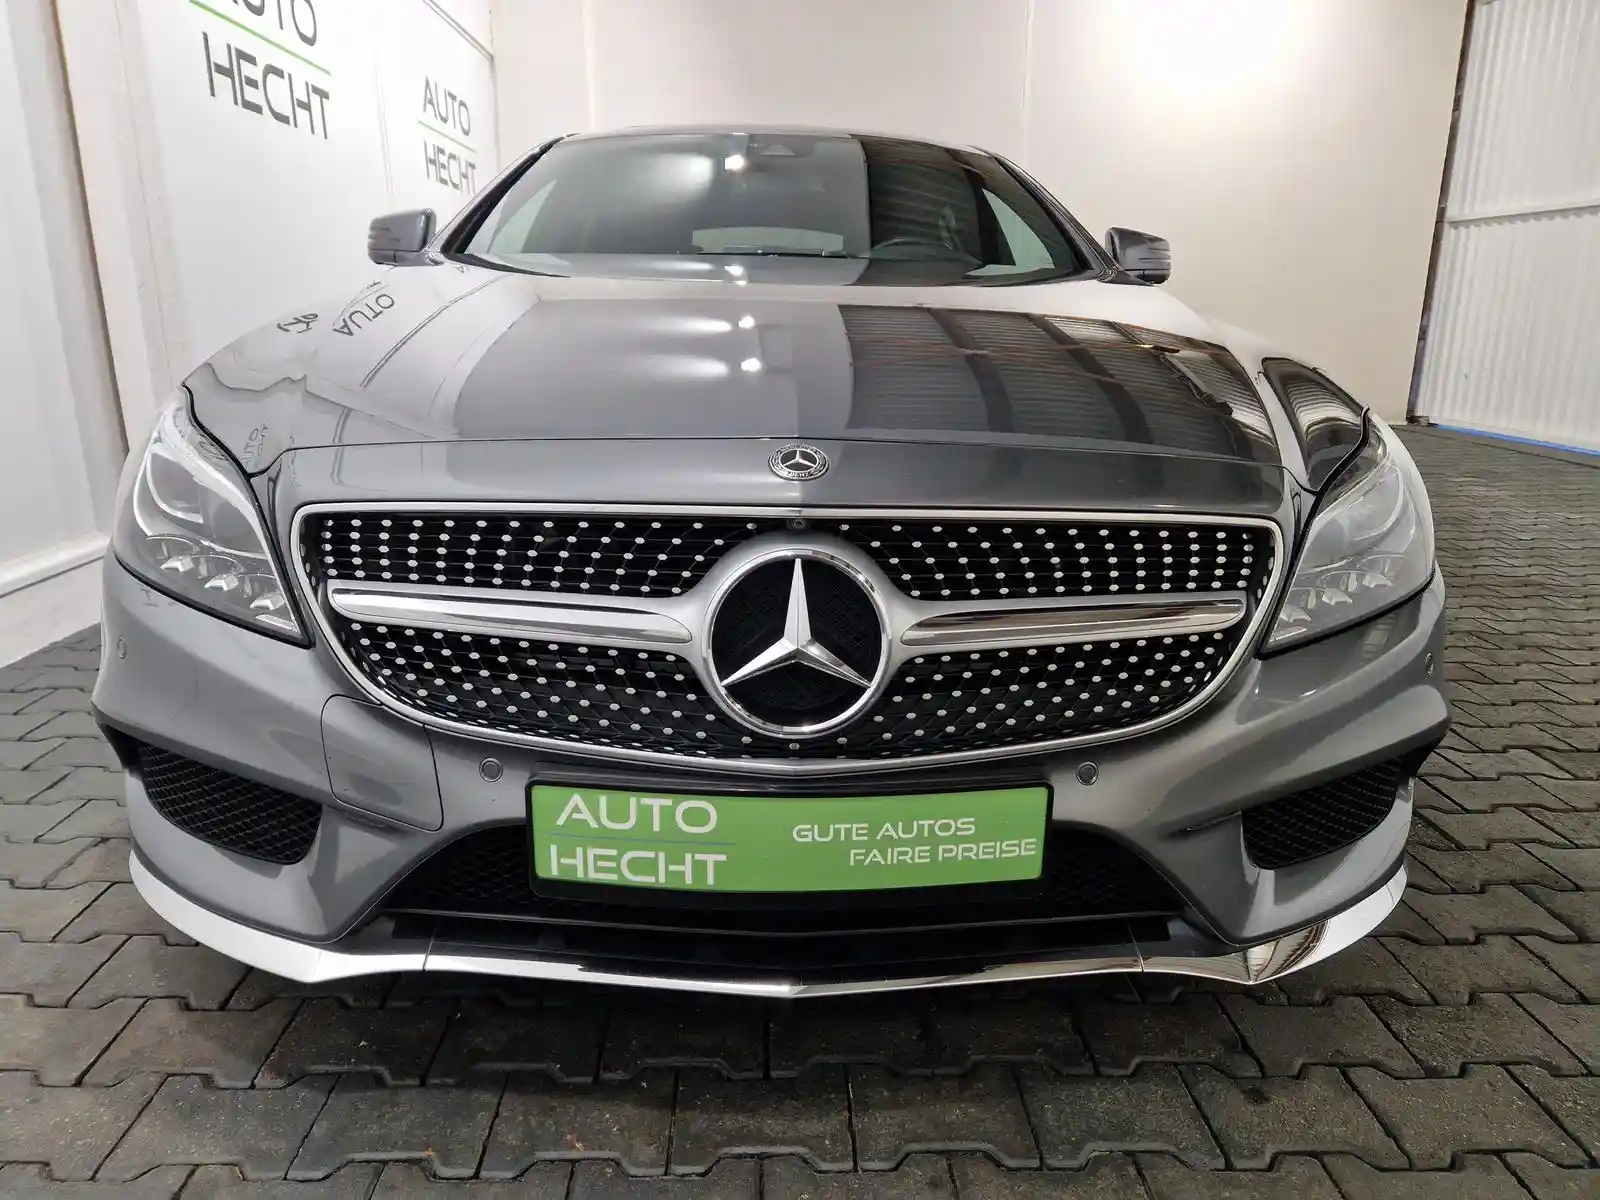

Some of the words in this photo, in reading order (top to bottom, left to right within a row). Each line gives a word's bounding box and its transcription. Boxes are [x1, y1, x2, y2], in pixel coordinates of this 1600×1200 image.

[202, 31, 330, 139] HECHT
[422, 76, 471, 136] AUTO
[423, 140, 476, 195] HECHT
[556, 793, 718, 834] AUTO
[792, 824, 868, 842] GUTE
[876, 817, 976, 840] AUTOS
[550, 844, 727, 885] HECHT
[850, 845, 931, 866] FAIRE
[938, 838, 1037, 863] PREISE
